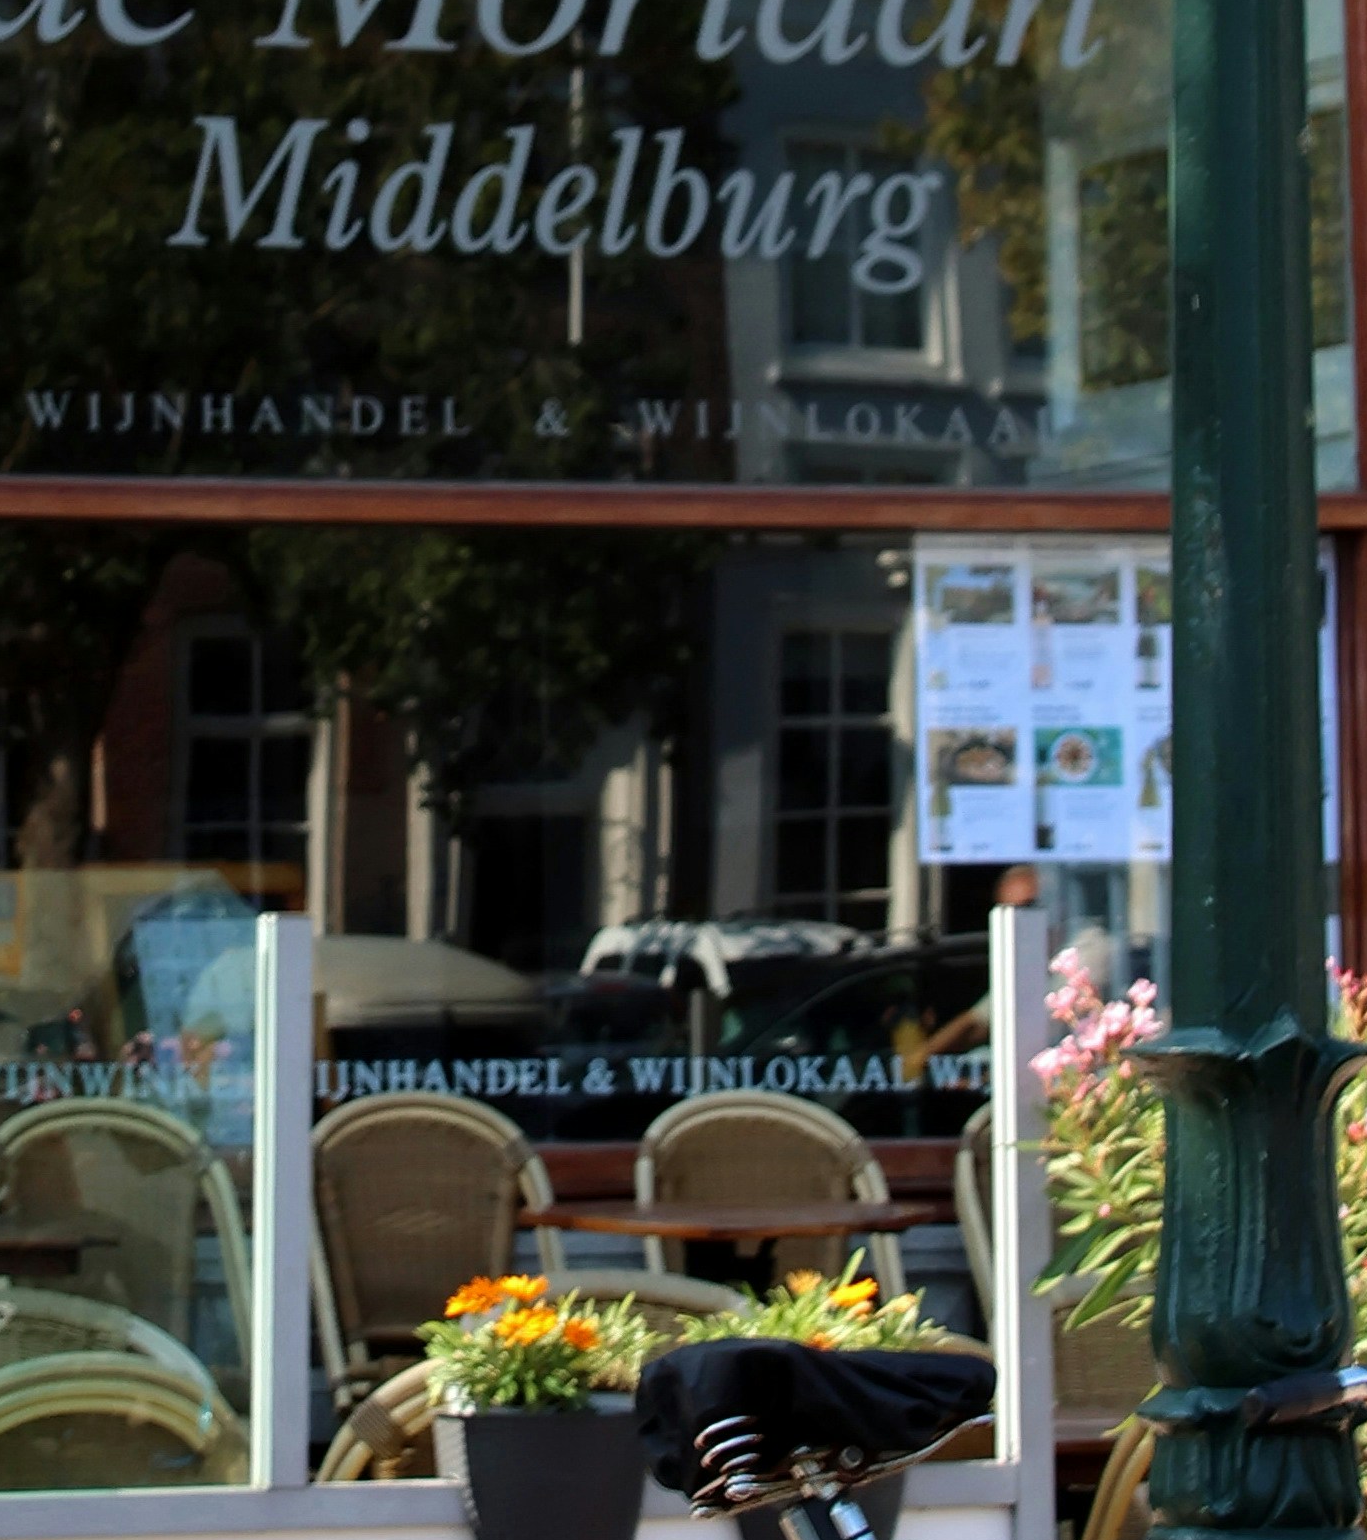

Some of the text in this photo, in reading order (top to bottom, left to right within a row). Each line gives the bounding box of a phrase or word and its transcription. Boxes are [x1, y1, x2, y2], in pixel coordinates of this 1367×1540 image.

[168, 116, 941, 294] Middelburg
[25, 391, 1058, 450] WIJNHANDEL & WIJNLOKAAL
[315, 1057, 571, 1098] IJNHANDEL
[582, 1057, 614, 1096] &
[629, 1055, 922, 1096] WIJNLOKAAL
